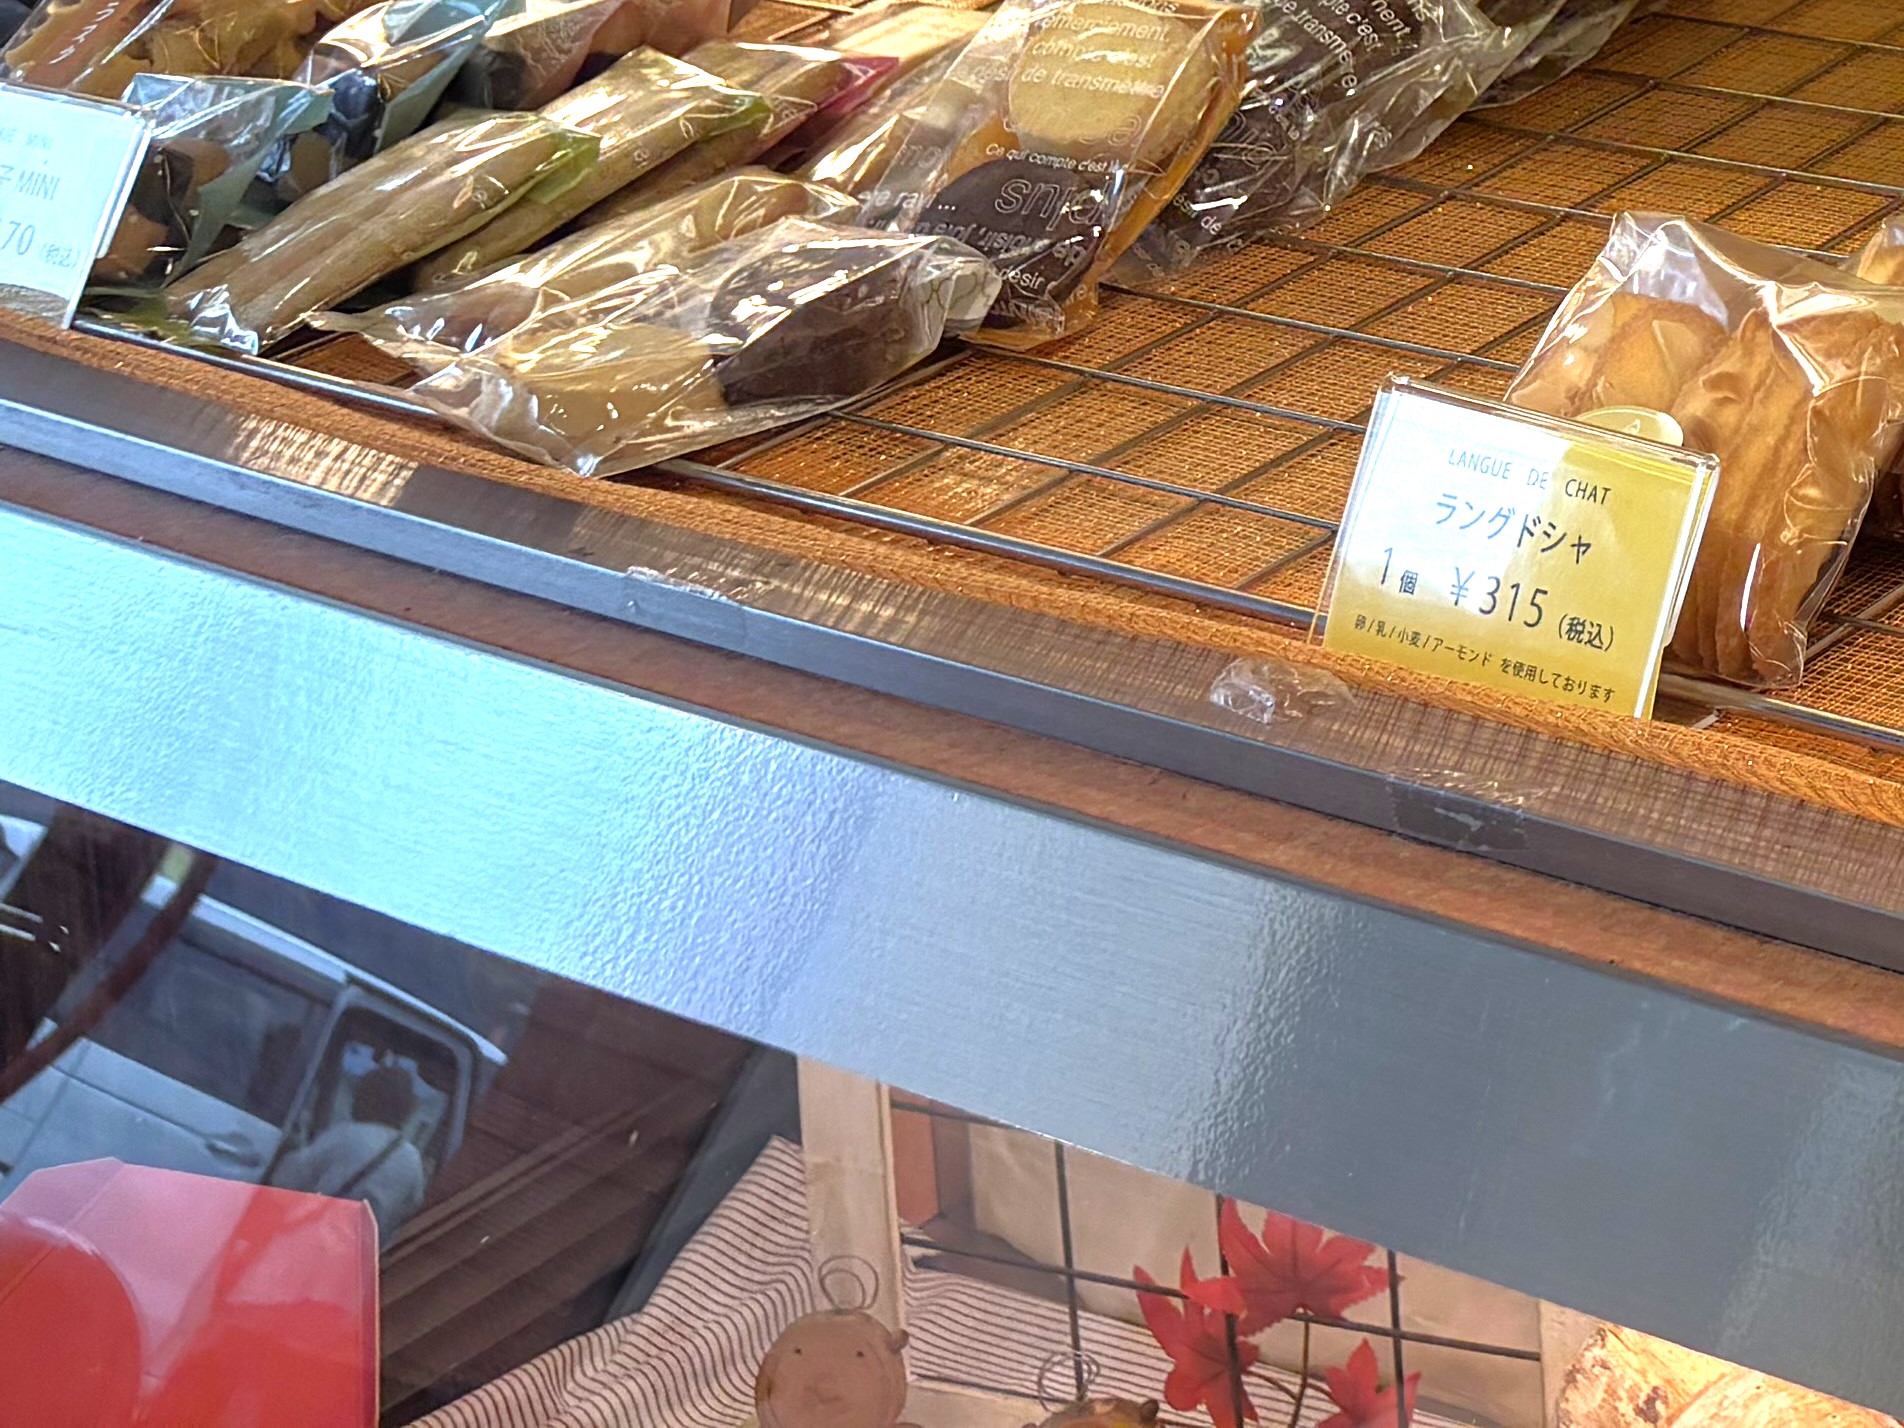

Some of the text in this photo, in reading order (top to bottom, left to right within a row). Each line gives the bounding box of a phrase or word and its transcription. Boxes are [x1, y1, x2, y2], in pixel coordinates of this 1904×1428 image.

[1448, 448, 1612, 505] LANGUE DE CHAT
[1436, 492, 1593, 566] ラングドシャ
